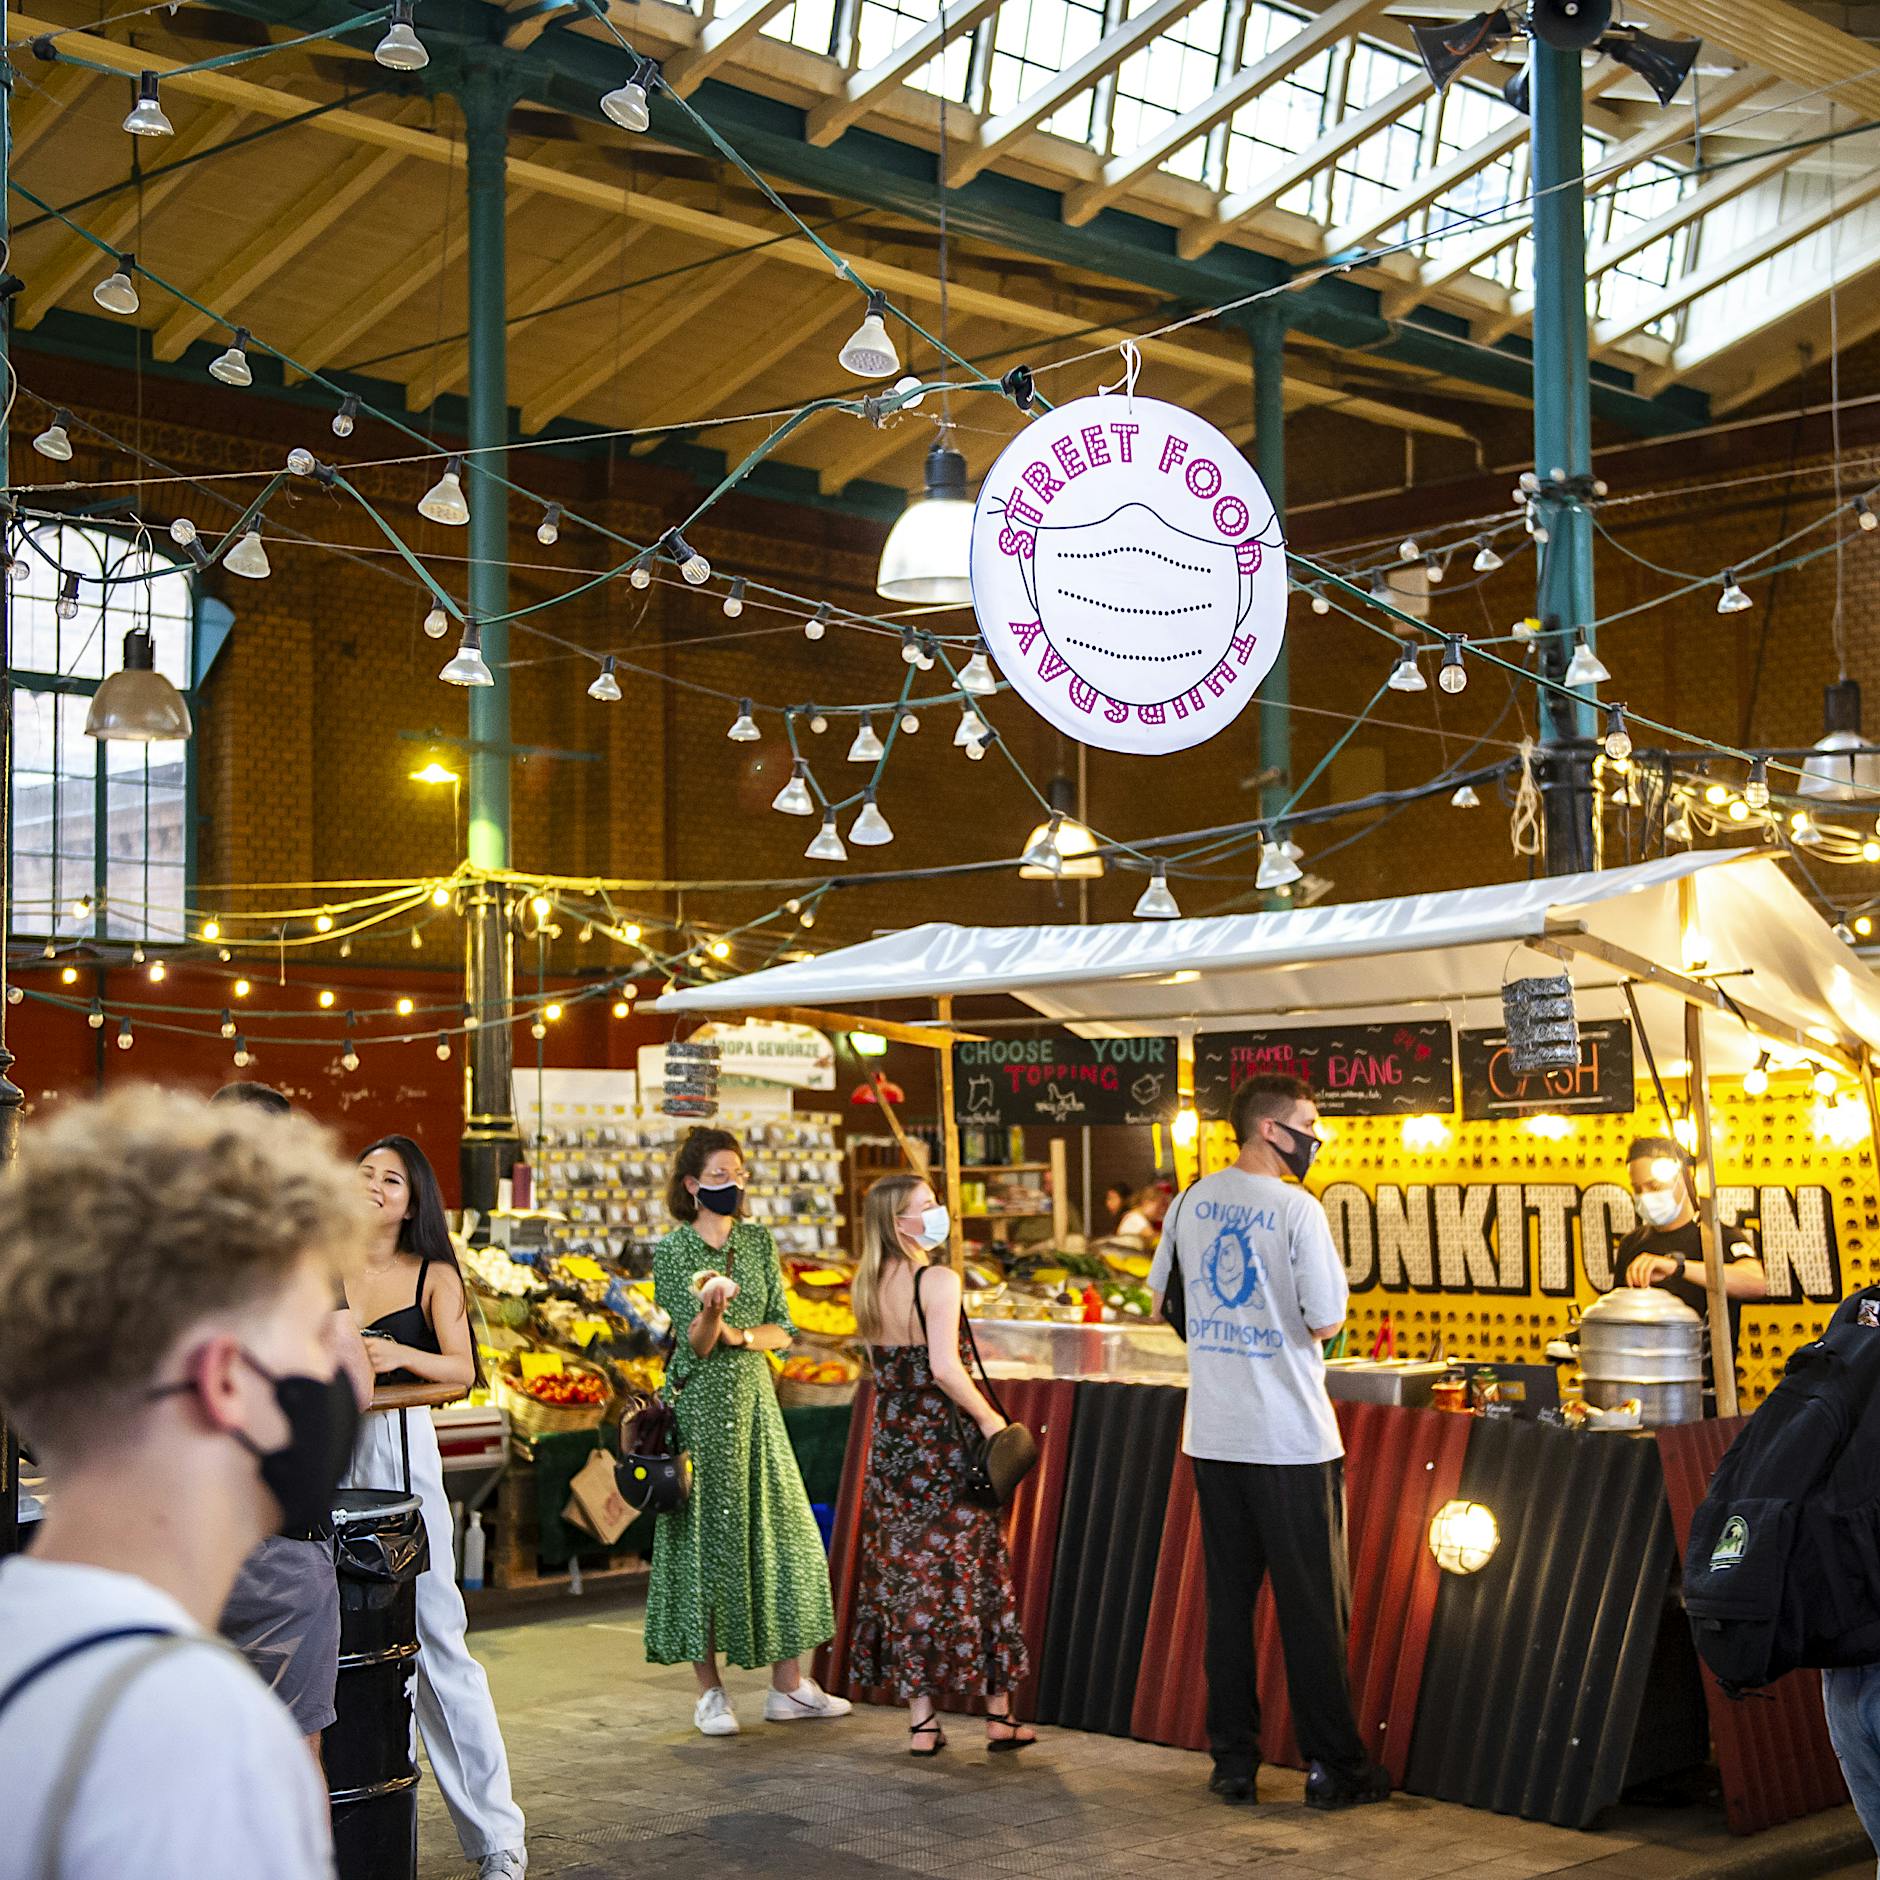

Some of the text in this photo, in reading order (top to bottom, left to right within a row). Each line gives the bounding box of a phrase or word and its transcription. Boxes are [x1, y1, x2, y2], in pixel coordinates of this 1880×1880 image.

[999, 423, 1262, 575] STREET FOOD
[959, 1037, 1166, 1065] CHOOSE YOUR
[1004, 1064, 1119, 1093] TOPPING
[1328, 1054, 1404, 1088] BANG
